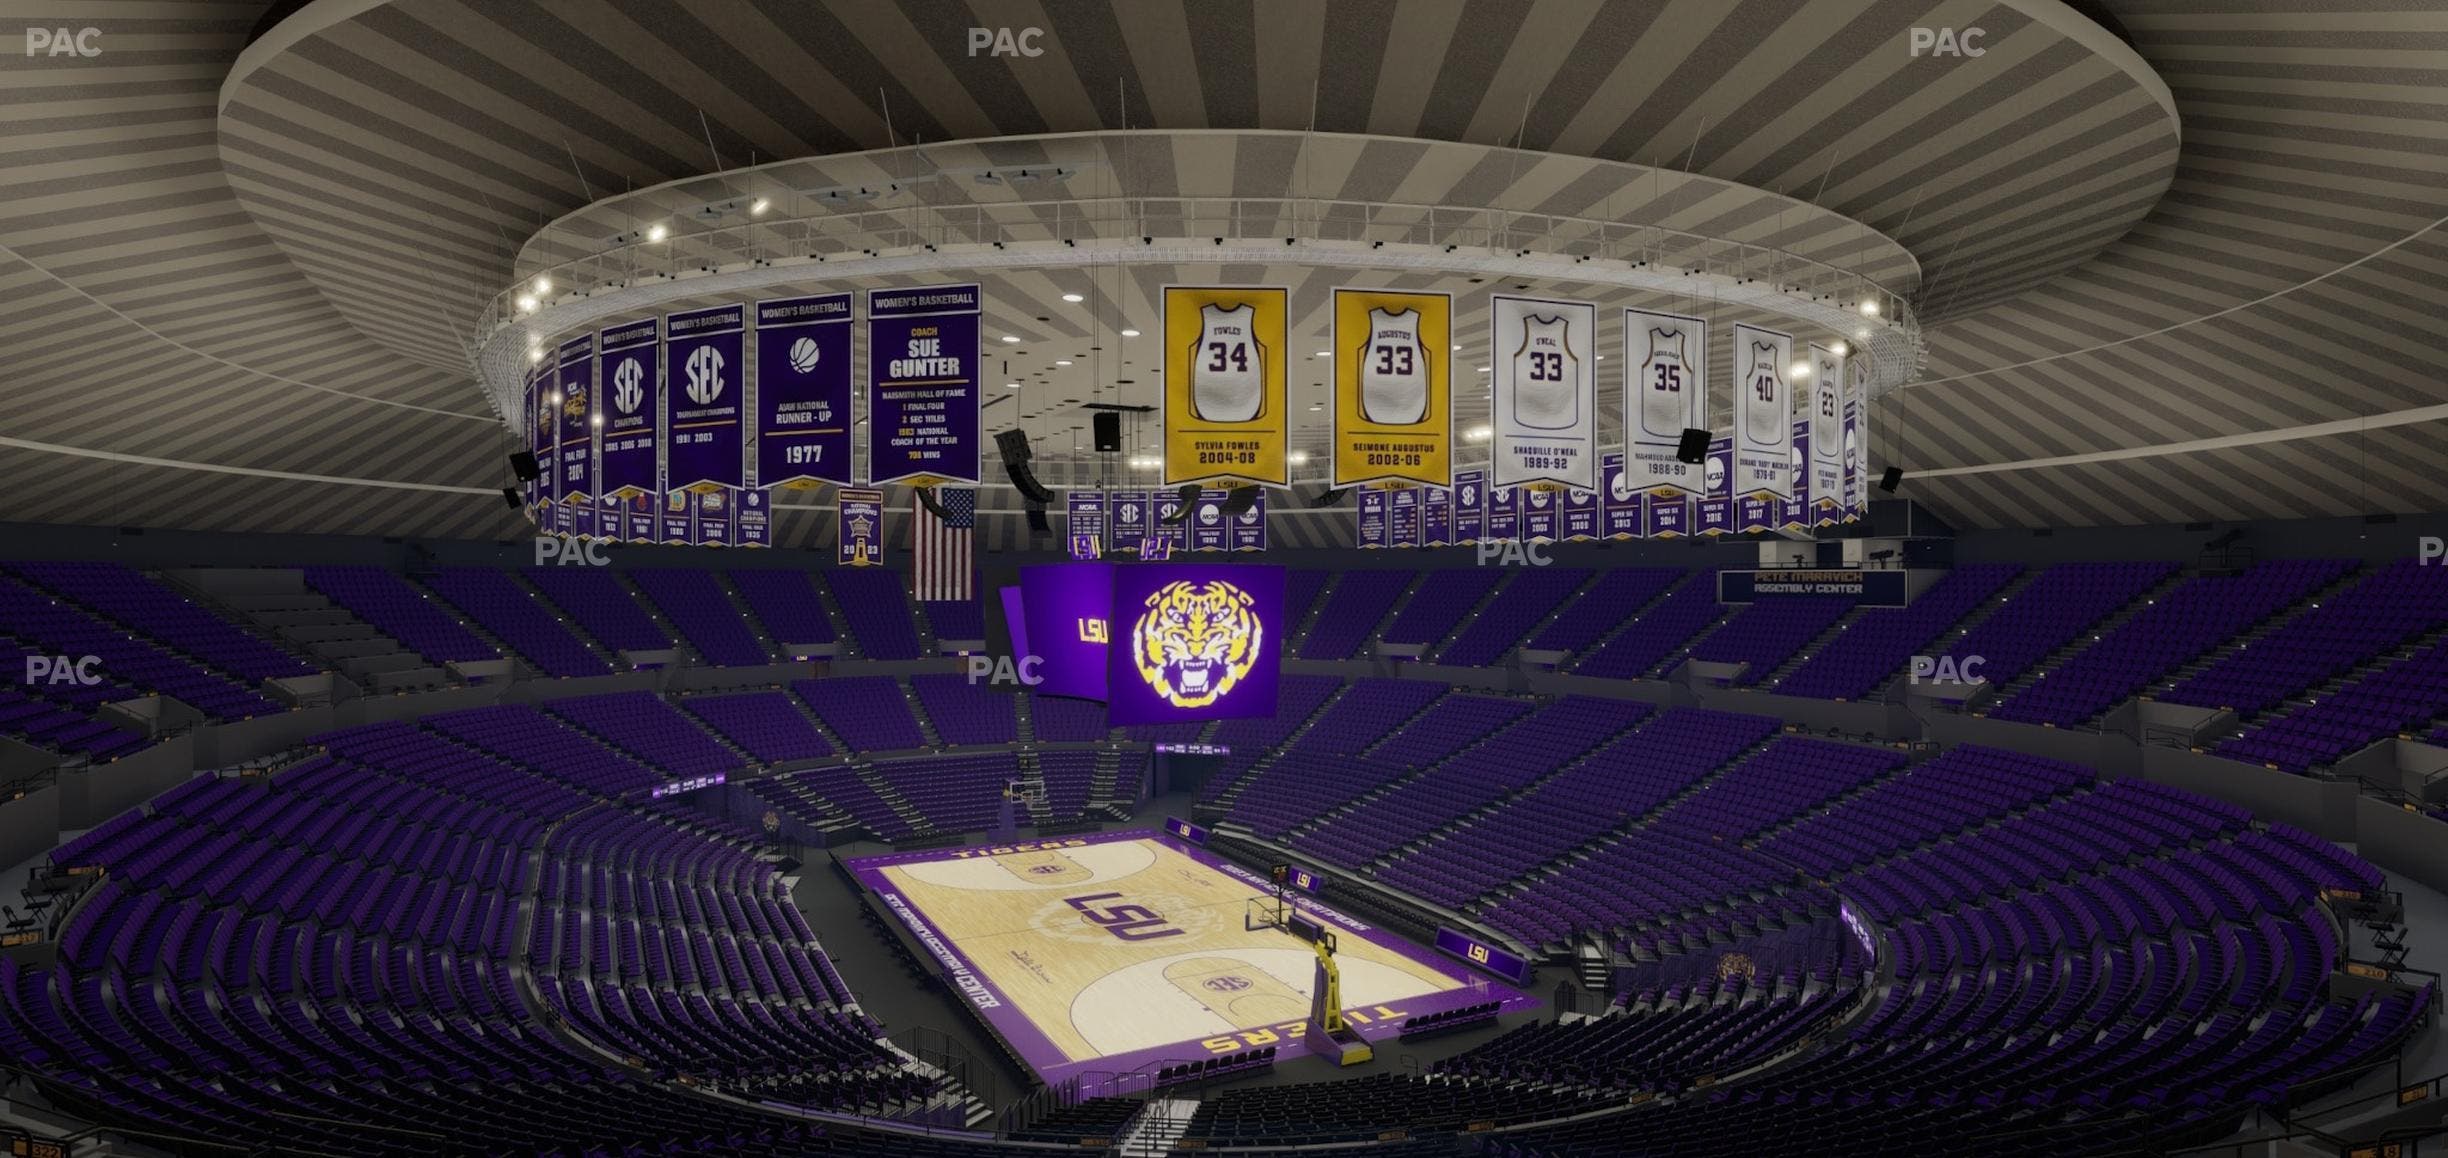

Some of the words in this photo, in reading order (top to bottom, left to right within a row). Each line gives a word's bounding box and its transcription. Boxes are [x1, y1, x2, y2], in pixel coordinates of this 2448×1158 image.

[761, 307, 798, 319] WOMEN'S
[799, 302, 847, 315] BASKETBALL
[875, 296, 917, 309] WOMEN'S
[919, 293, 974, 306] BASKETBALL
[911, 327, 938, 337] COACH
[908, 338, 941, 358] SUE
[1209, 342, 1248, 372] 34
[889, 357, 960, 378] GUNTER
[1376, 345, 1413, 375] 33
[1530, 351, 1562, 382] 33
[685, 345, 725, 405] SEC
[1655, 363, 1680, 392] 35
[614, 358, 644, 414] SEC
[1755, 375, 1773, 402] 40
[786, 445, 822, 464] 1977
[1195, 441, 1223, 450] SYLVIA
[1226, 441, 1260, 450] FOWLES
[1353, 443, 1390, 452] SEIMONE
[1392, 444, 1435, 453] AUGUSTUS
[1513, 446, 1552, 455] SHAQUILLE
[1553, 447, 1578, 456] O'NEAL
[1199, 452, 1256, 464] 2004-08
[1368, 454, 1421, 466] 2002-06
[1524, 457, 1568, 470] 1989-92
[1754, 571, 1789, 582] PETE
[1791, 571, 1863, 582] MARAVICH
[1754, 584, 1813, 593] ASSEMBLY
[1816, 584, 1863, 594] CENTER
[1078, 618, 1109, 644] LSU
[950, 839, 1087, 858] TIGERS
[1296, 872, 1312, 889] LSU
[1063, 892, 1186, 941] LSU
[1467, 943, 1489, 964] LSU
[954, 974, 1001, 1009] CENTER
